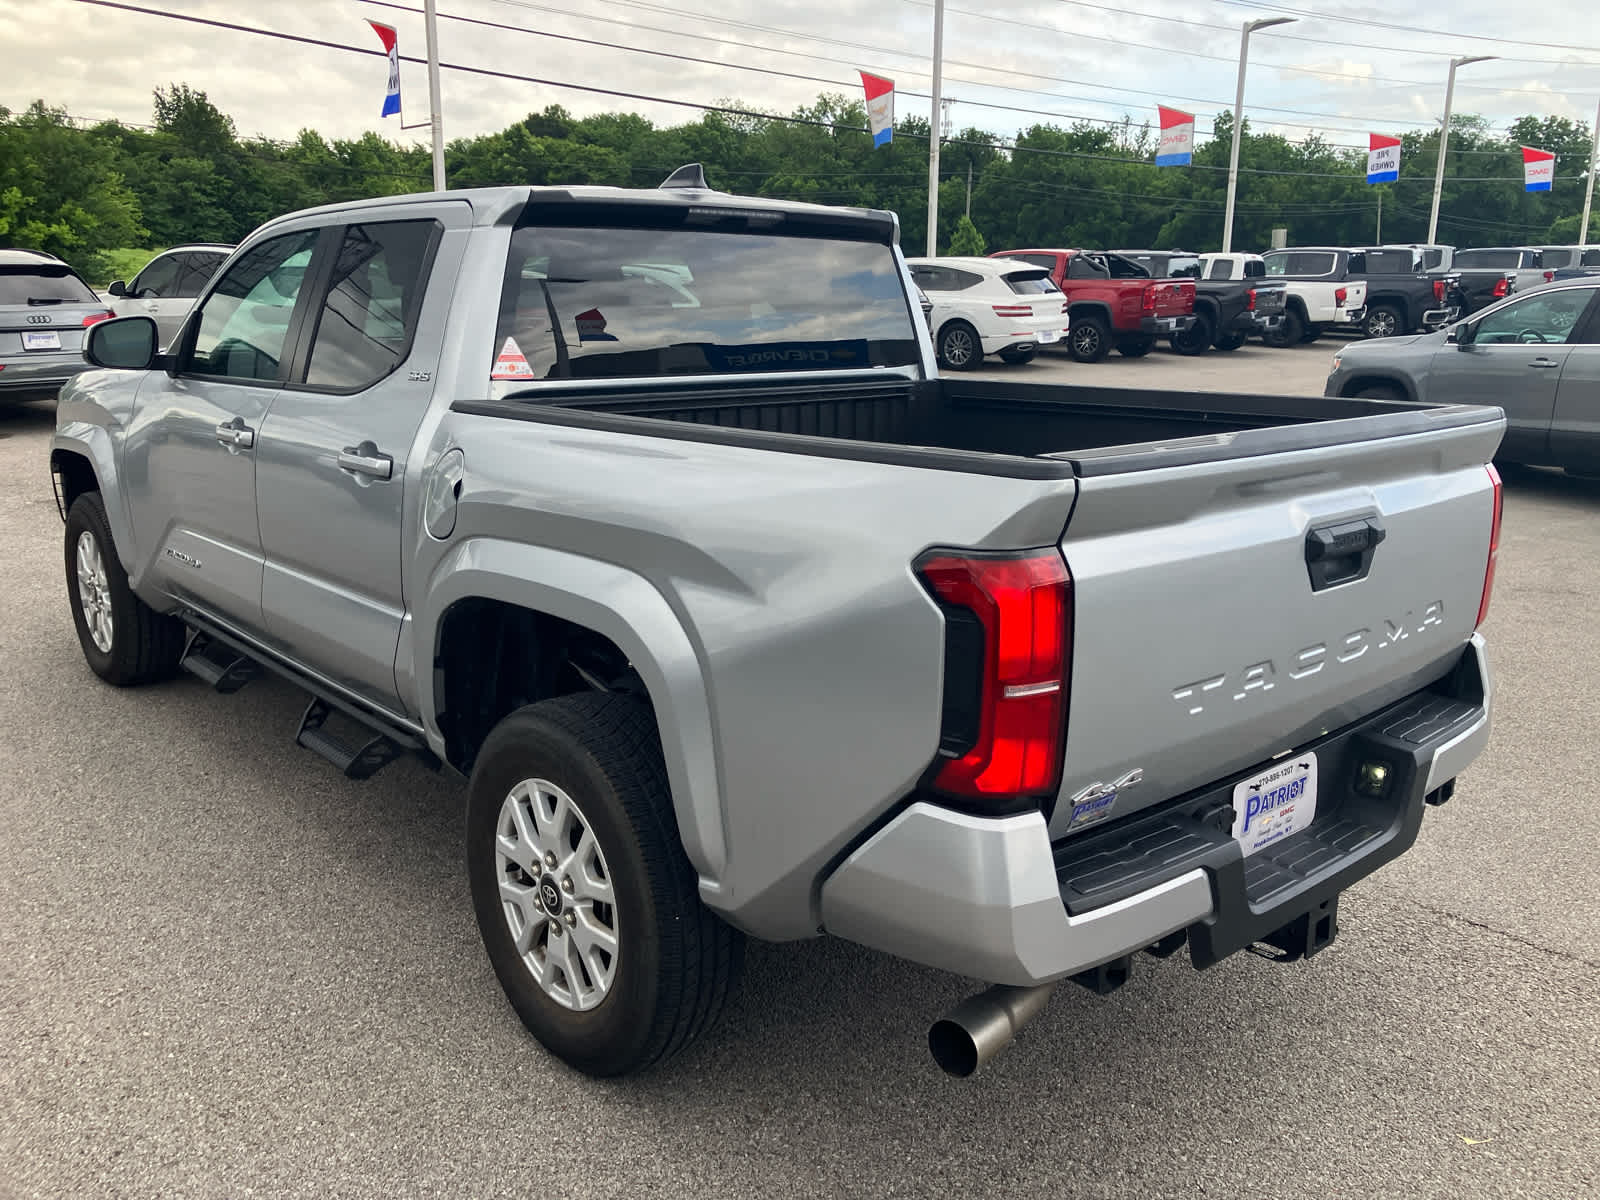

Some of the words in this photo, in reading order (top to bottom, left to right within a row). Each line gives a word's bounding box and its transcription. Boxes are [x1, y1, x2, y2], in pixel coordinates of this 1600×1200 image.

[1172, 600, 1444, 714] TACOMA
[1243, 776, 1308, 833] PATRIOT
[1279, 804, 1296, 817] GMC
